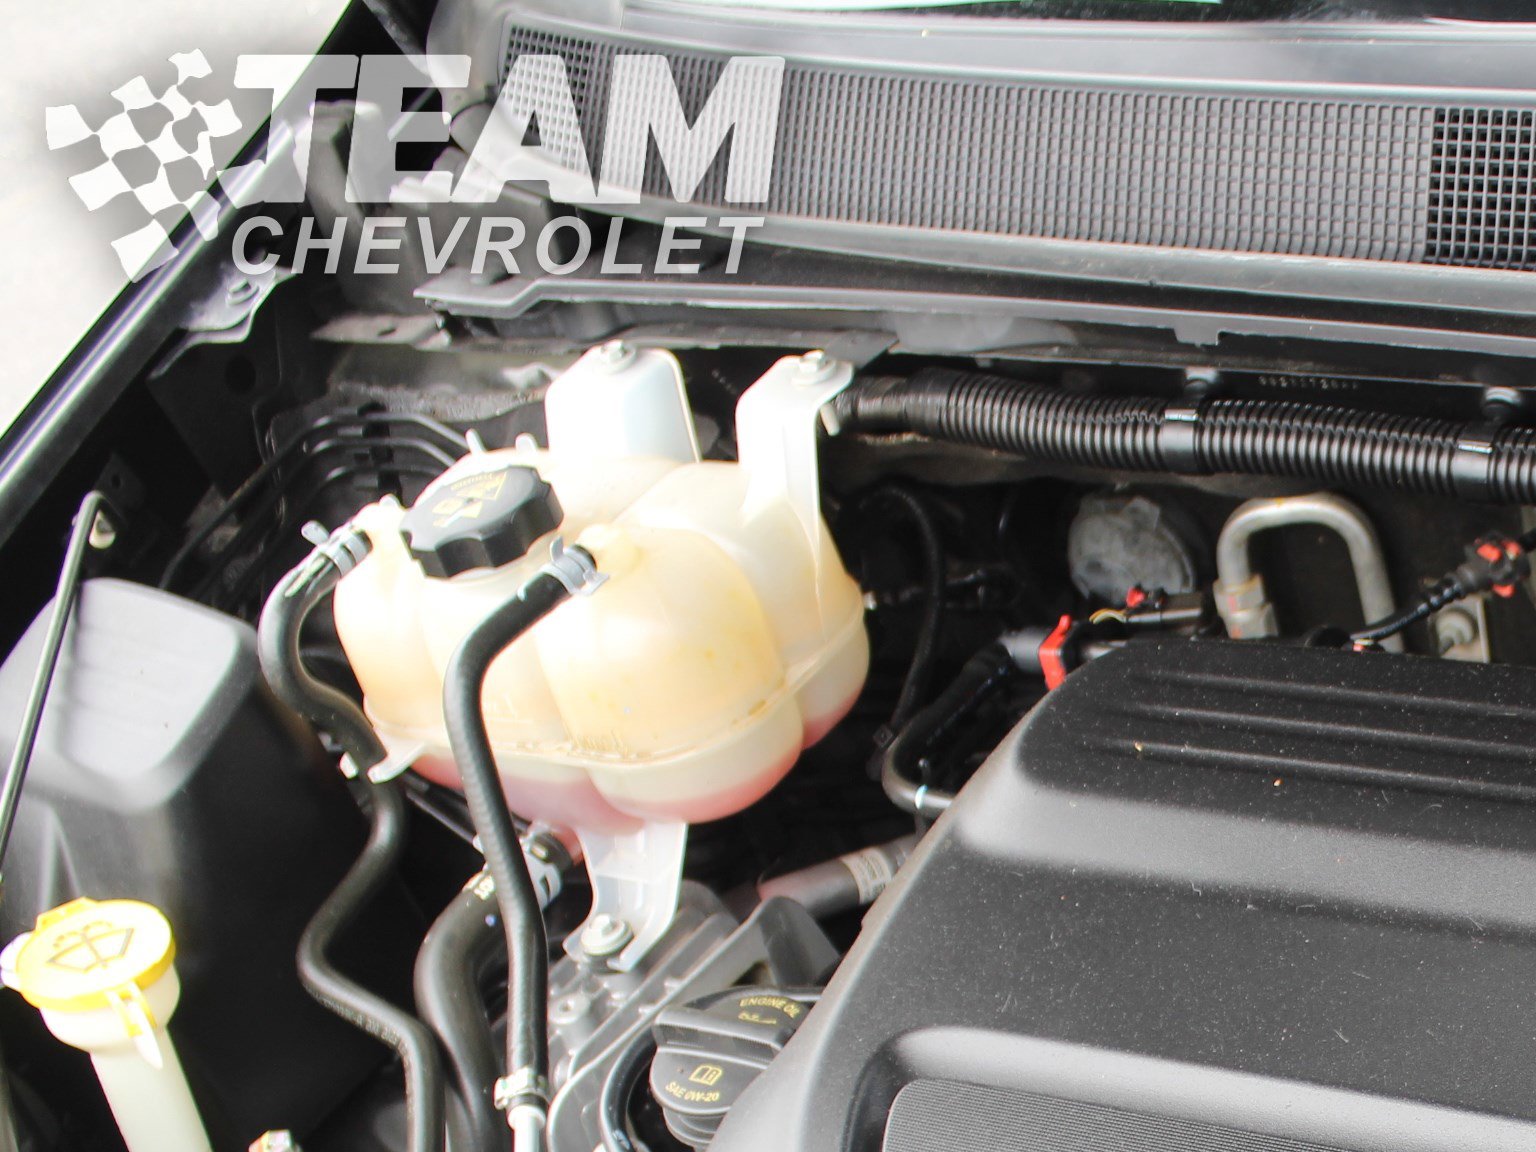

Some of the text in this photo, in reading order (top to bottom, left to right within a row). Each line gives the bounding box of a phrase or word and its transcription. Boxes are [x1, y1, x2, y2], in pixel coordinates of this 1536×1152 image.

[739, 996, 802, 1019] ENGINE OIL
[665, 1081, 720, 1102] SAE 0W-20
